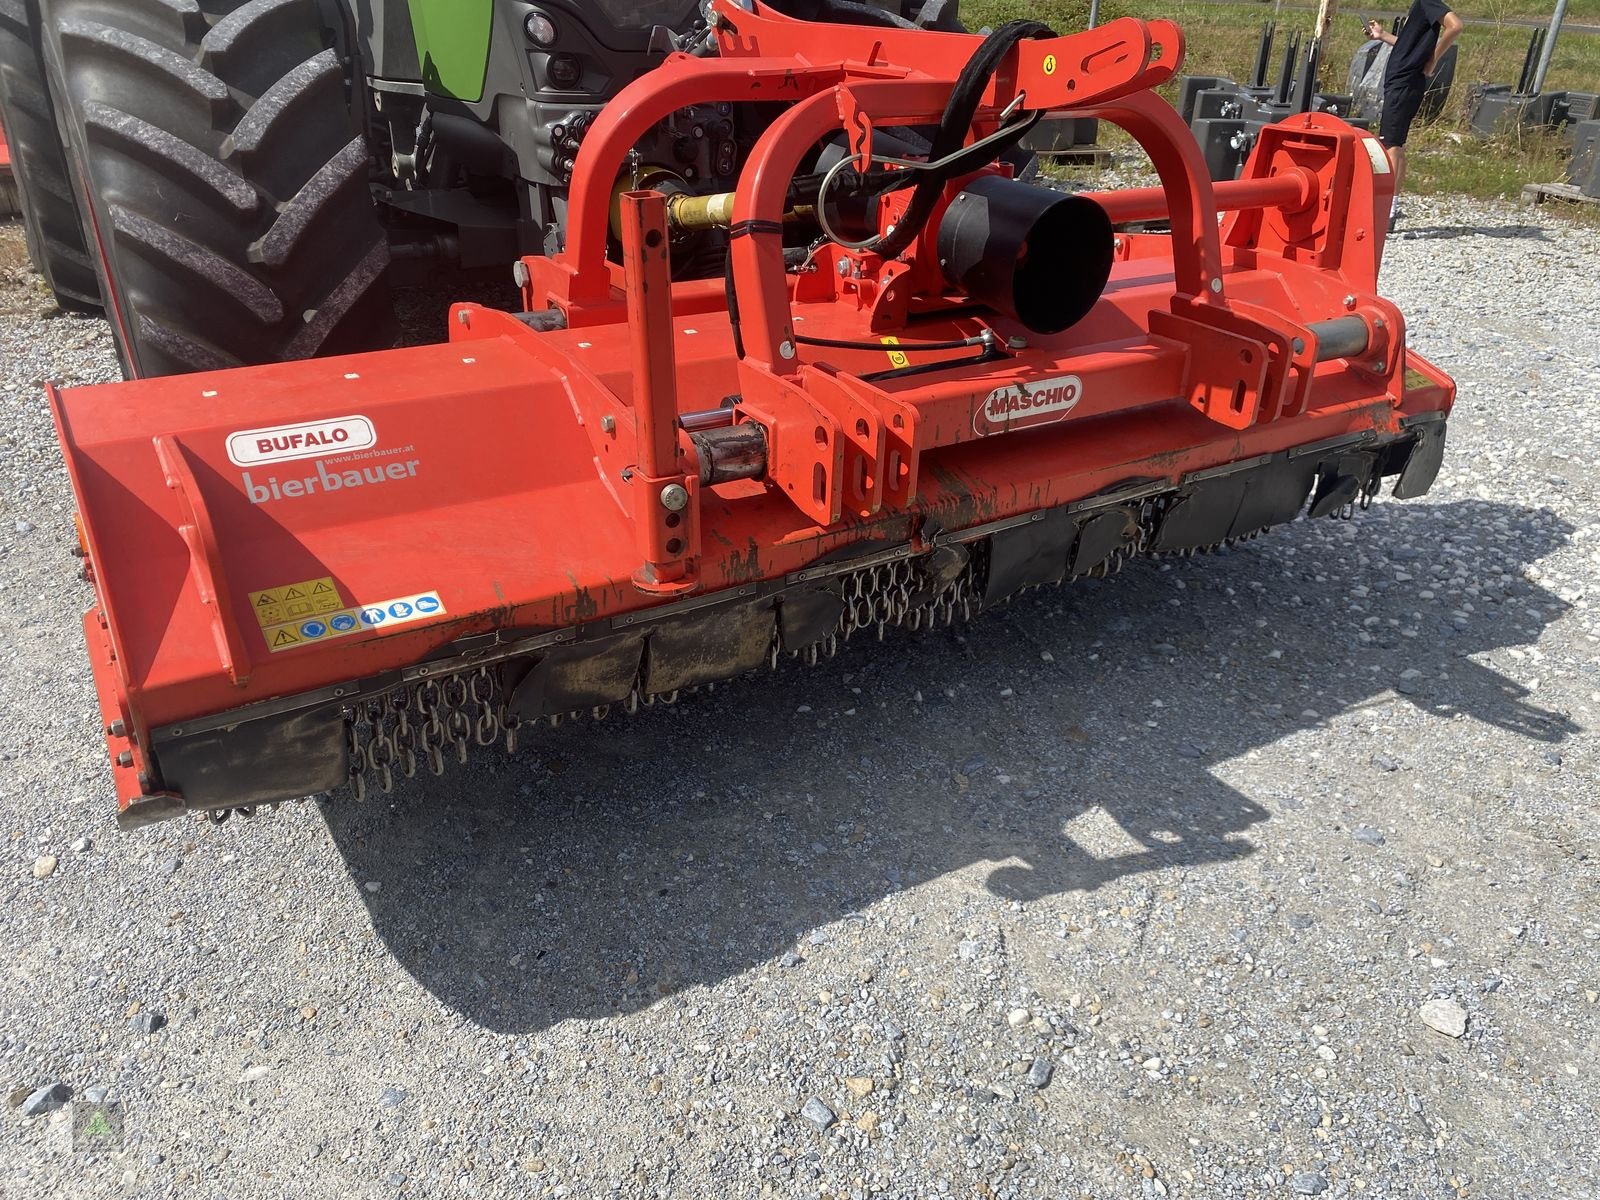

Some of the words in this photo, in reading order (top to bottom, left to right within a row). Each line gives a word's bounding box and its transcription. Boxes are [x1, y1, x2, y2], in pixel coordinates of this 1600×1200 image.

[989, 384, 1076, 416] MASCHIO
[256, 428, 348, 454] BUFALO
[324, 444, 415, 465] www.bierbauer.at
[241, 459, 420, 504] bierbauer
